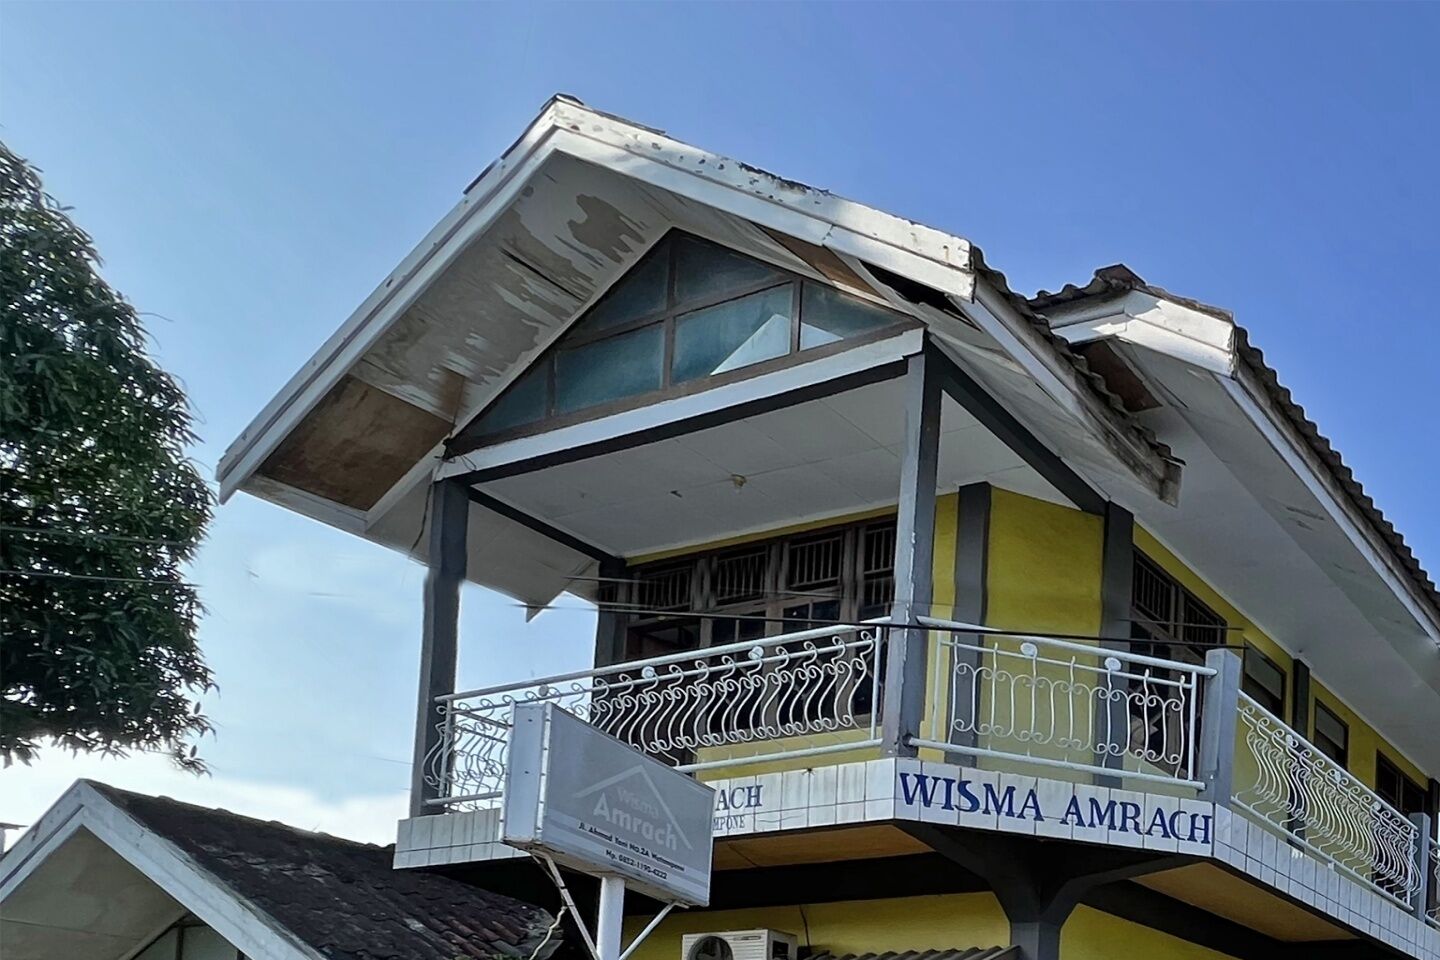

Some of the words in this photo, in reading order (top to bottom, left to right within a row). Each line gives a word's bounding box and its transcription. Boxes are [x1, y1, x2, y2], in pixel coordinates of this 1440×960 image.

[615, 786, 660, 818] Wisma
[715, 785, 764, 811] ACH
[899, 772, 1045, 822] WISMA
[1060, 795, 1212, 844] AMRACH
[592, 791, 678, 851] Amrach
[712, 815, 746, 831] MPONE
